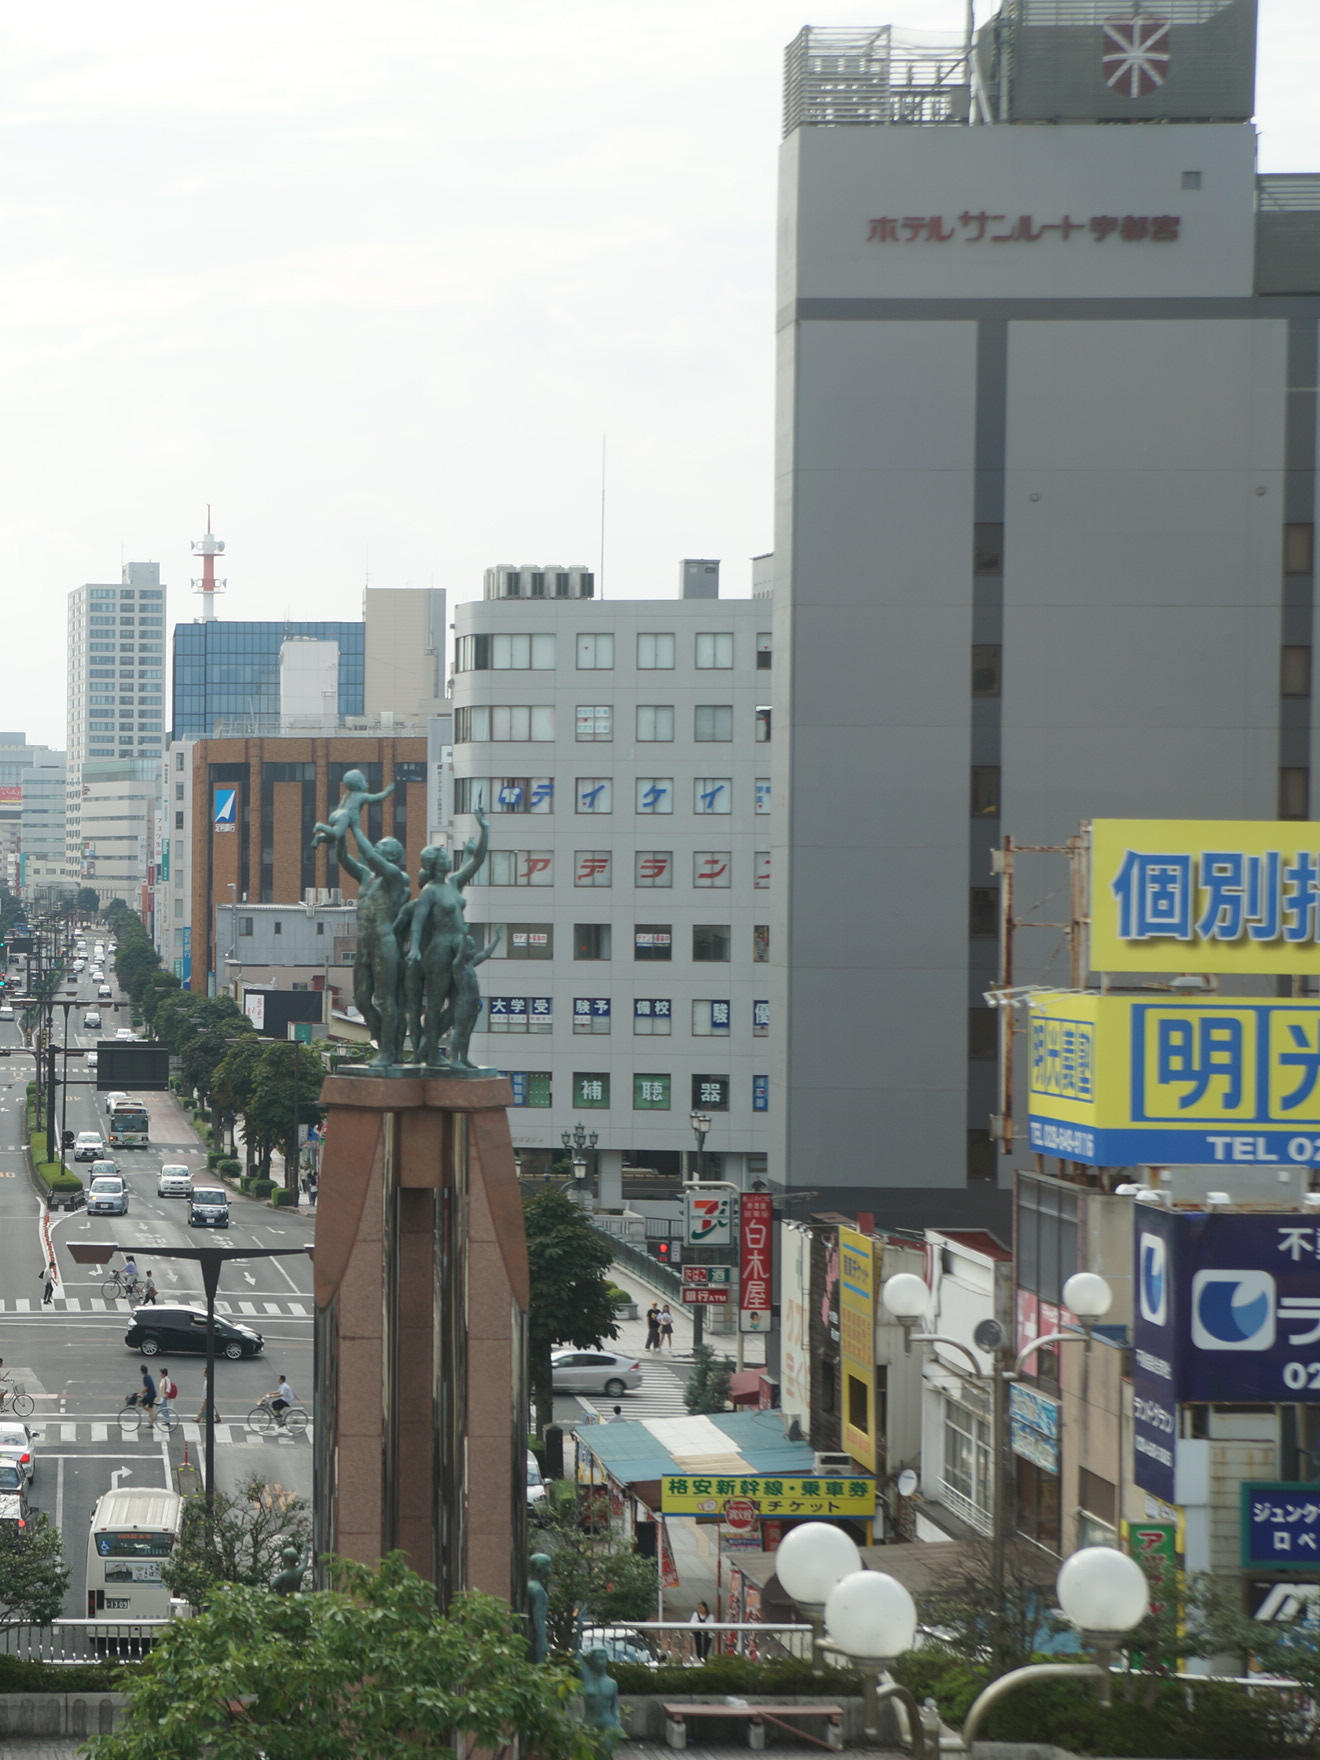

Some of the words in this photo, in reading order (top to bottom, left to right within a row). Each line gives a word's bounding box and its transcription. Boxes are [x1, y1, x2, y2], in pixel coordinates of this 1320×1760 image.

[867, 211, 1180, 243] ホテルサンルート宇都宮
[1206, 1137, 1278, 1161] TEL
[1288, 1137, 1320, 1162] 0
[1278, 1228, 1320, 1261] 不
[684, 1269, 707, 1282] たばこ
[742, 1219, 769, 1309] 白木屋
[668, 1478, 869, 1498] 格安新幹線・乗車券
